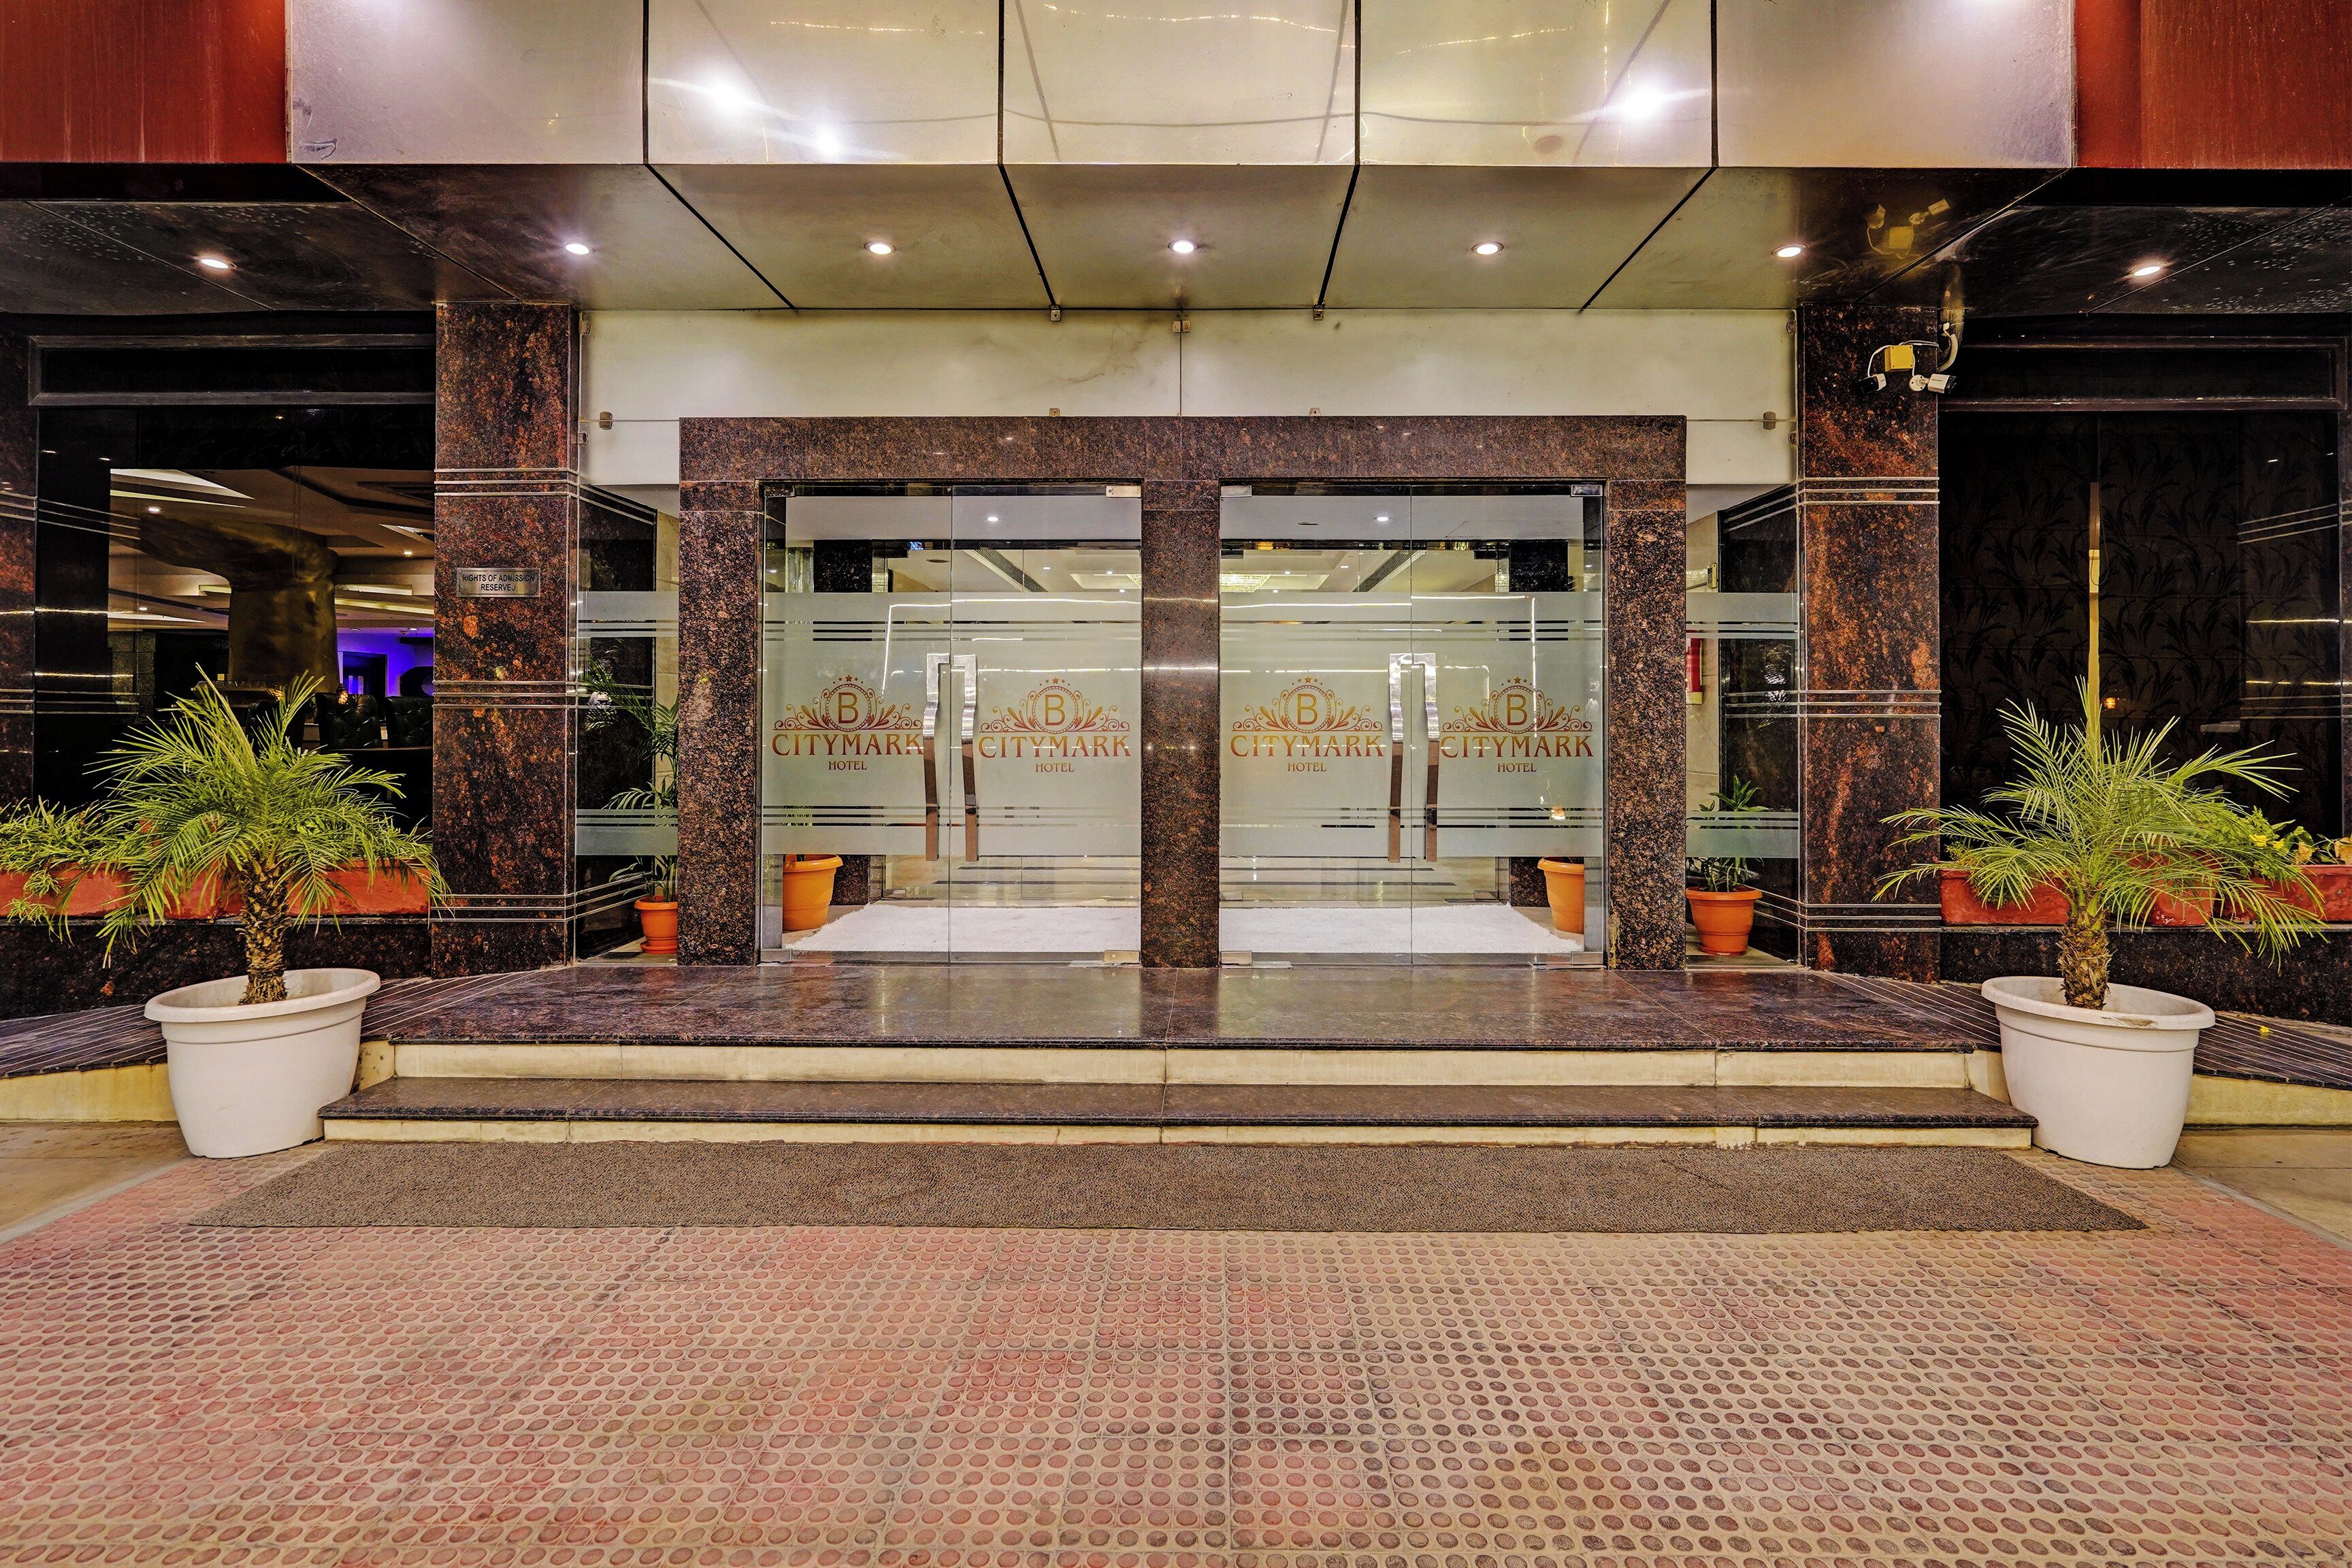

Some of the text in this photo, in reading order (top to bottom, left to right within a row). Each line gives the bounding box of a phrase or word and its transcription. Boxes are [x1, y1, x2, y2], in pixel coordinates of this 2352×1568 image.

[837, 691, 858, 724] B
[1045, 693, 1066, 726] B
[1297, 693, 1318, 725] B
[1507, 693, 1529, 726] B
[772, 732, 924, 757] CITYMARK
[979, 734, 1132, 758] CITYMARK
[1230, 734, 1385, 757] CITYMARK
[1440, 734, 1595, 759] CITYMARK
[828, 761, 868, 771] HOTEL
[1035, 762, 1075, 773] HOTEL
[1287, 762, 1327, 773] HOTEL
[1497, 762, 1537, 773] HOTEL
